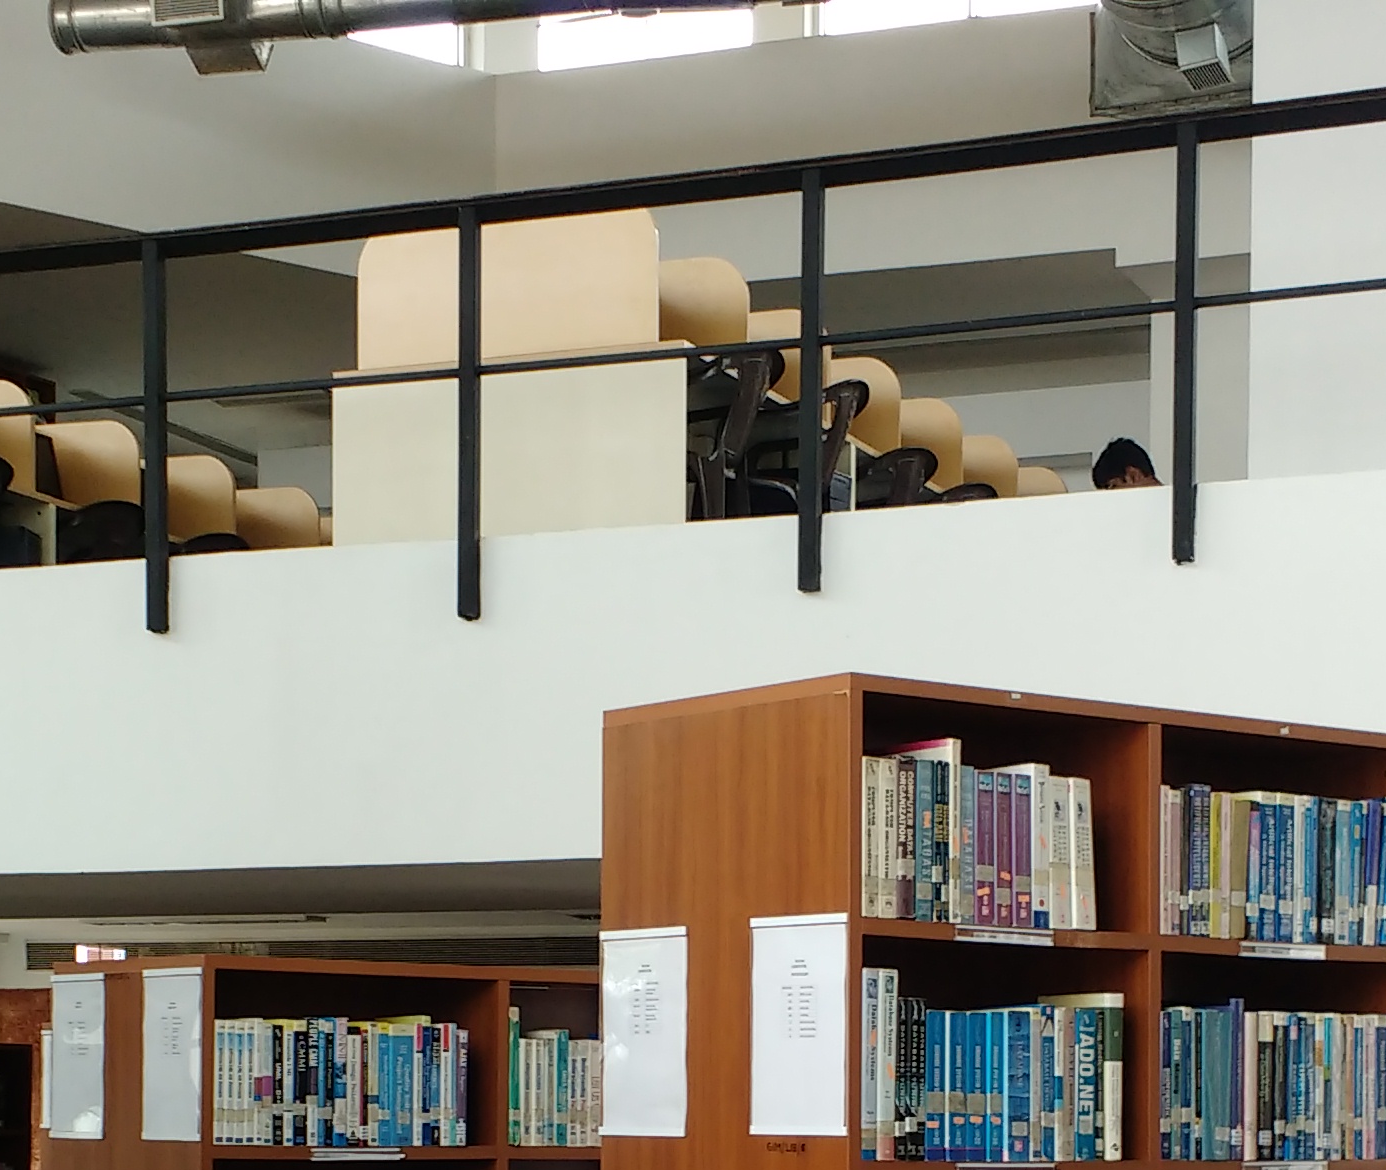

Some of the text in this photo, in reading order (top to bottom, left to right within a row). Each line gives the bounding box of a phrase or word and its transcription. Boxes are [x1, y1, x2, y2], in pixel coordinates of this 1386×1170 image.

[898, 771, 907, 843] ORGANIZATION
[906, 771, 915, 826] COMPUTER
[298, 1041, 306, 1071] CMMI
[1079, 1033, 1095, 1120] ADO.NET
